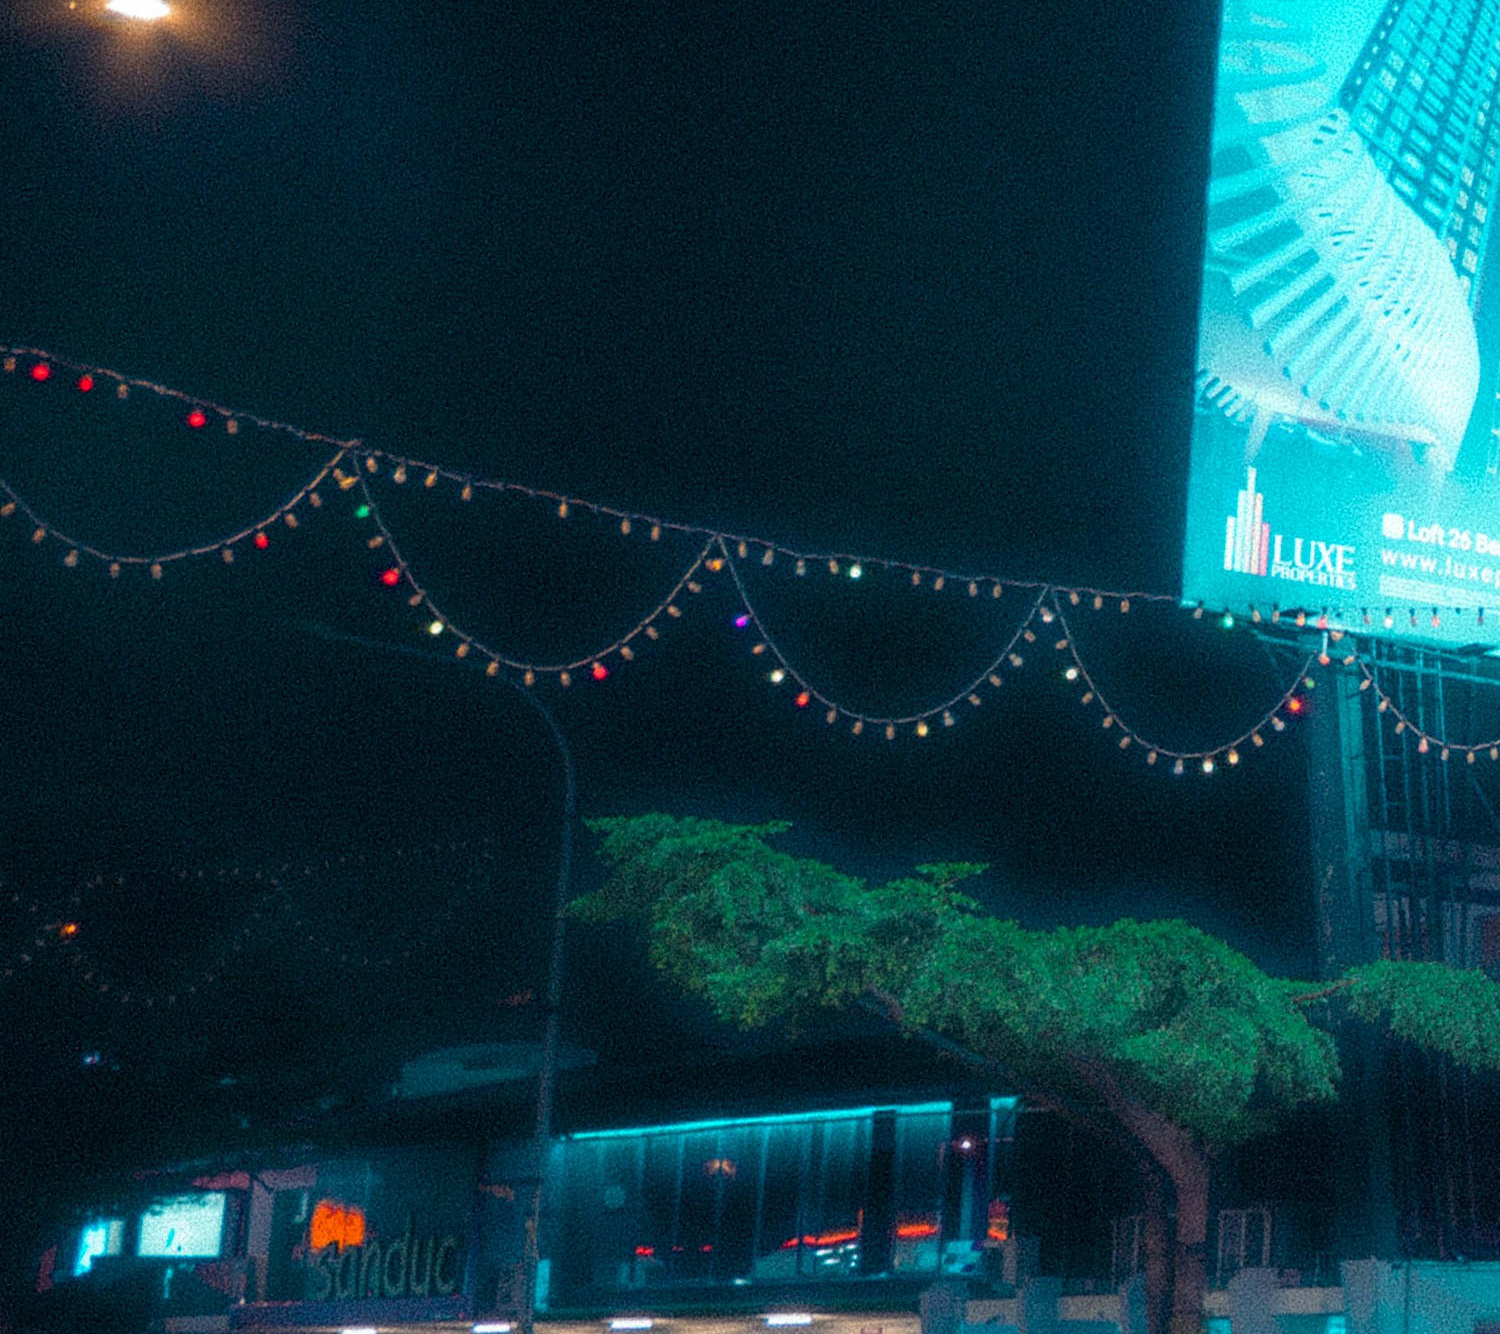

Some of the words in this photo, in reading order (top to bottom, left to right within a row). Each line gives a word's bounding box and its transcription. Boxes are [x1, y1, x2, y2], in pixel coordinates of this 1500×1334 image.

[1407, 519, 1444, 545] Loft
[1448, 526, 1471, 550] 26
[1274, 533, 1356, 574] LUXE
[1271, 564, 1357, 590] PROPERTIES
